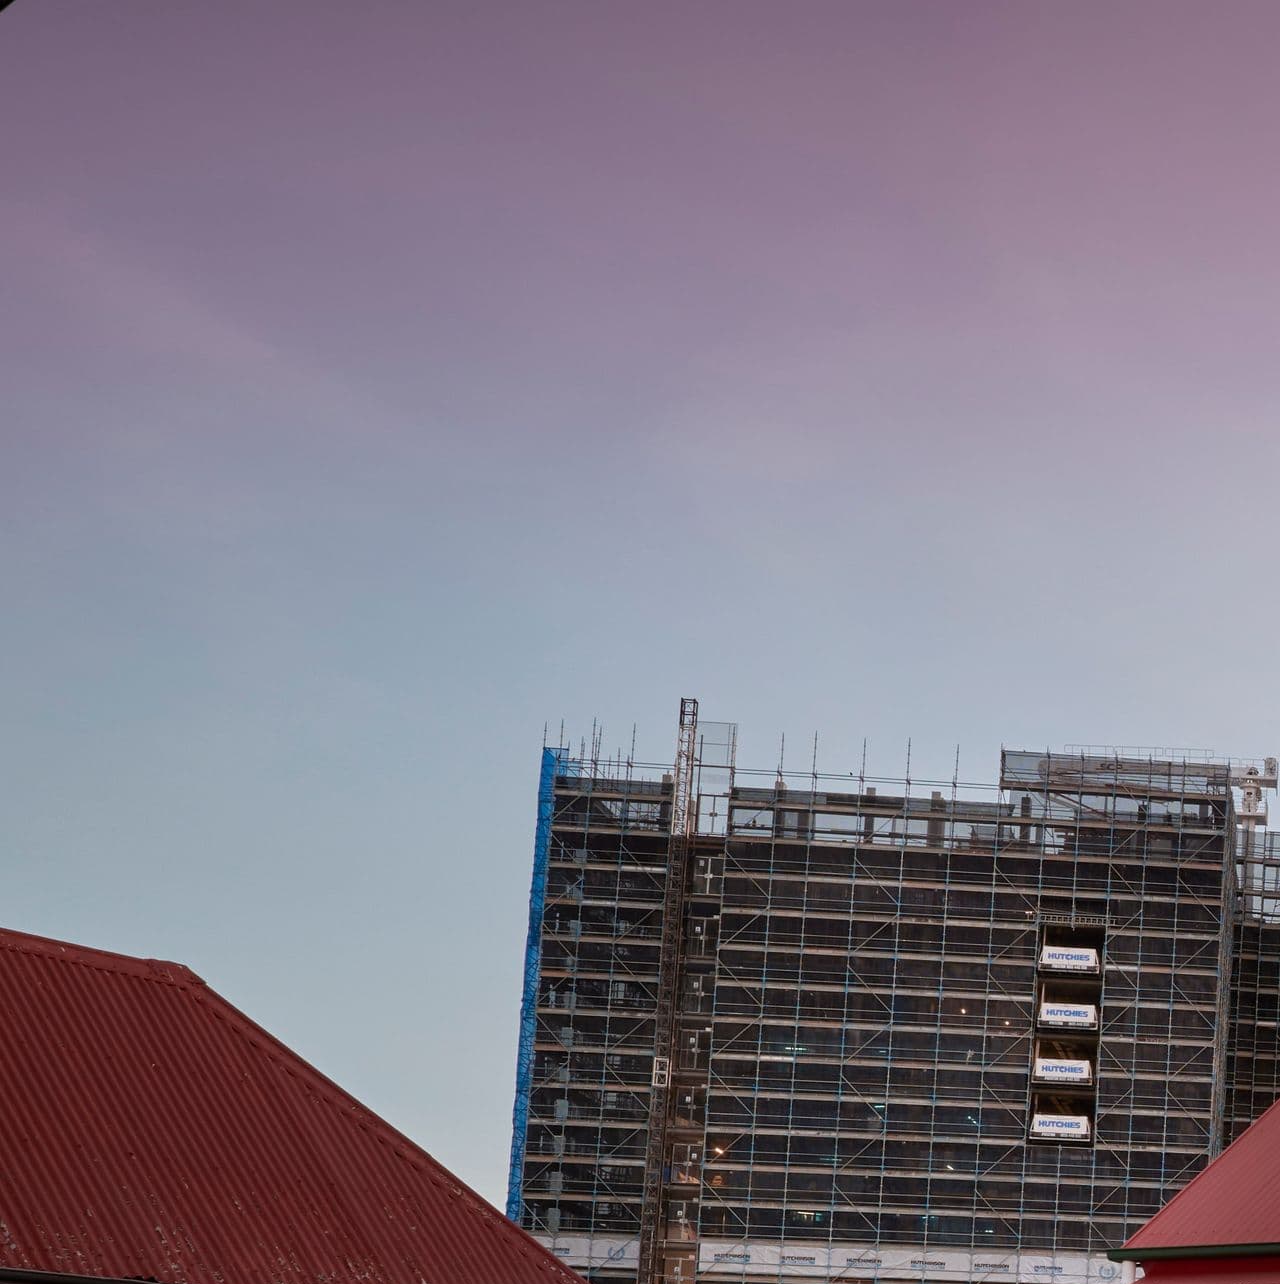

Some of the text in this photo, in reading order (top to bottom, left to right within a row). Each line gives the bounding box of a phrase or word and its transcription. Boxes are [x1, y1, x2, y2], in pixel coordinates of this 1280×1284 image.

[1048, 952, 1090, 962] HUTCHIES
[1046, 1008, 1088, 1018] HUTCHIES
[1042, 1064, 1084, 1074] HUTCHIES
[1039, 1119, 1080, 1129] HUTCHIES
